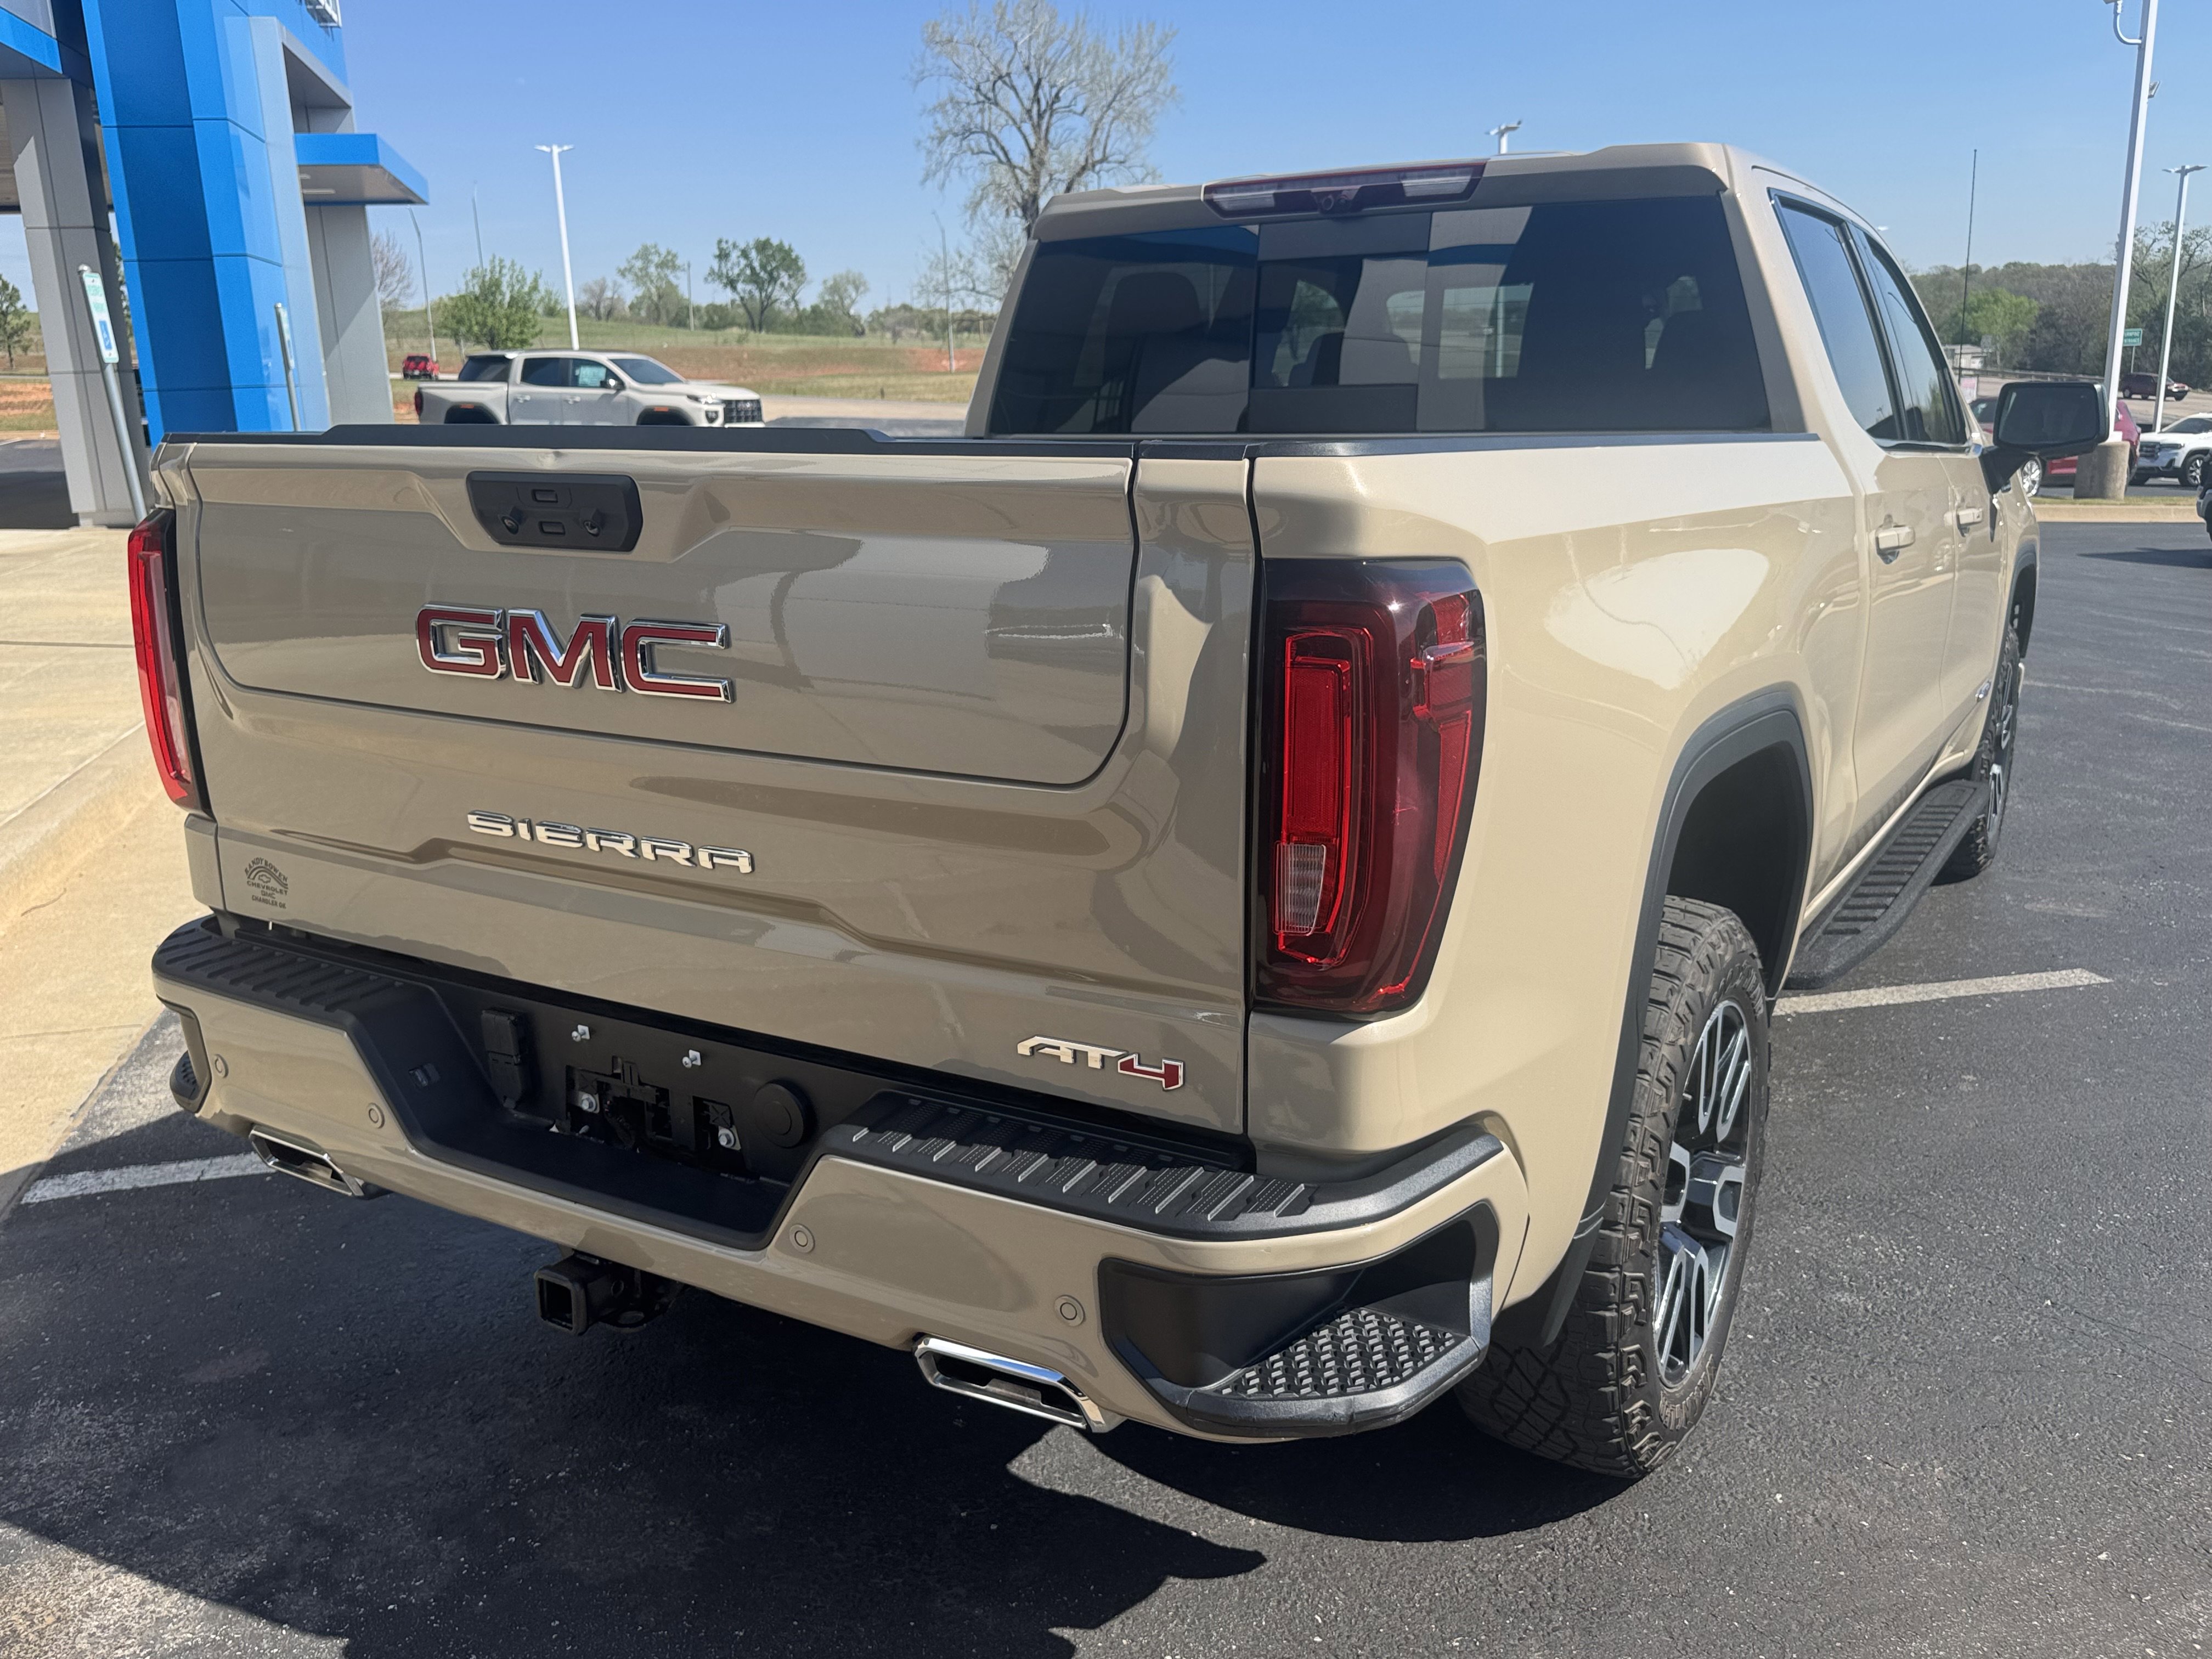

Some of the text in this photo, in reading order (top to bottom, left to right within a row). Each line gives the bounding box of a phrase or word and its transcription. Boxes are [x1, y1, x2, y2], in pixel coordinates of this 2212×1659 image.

[416, 601, 734, 703] GMC
[467, 809, 754, 874] SIERRA
[245, 857, 287, 883] RANDY BOWEN
[247, 880, 287, 896] CHEVROLET
[252, 895, 278, 907] CHANDLER
[261, 890, 275, 899] GMC
[1017, 1035, 1184, 1091] AT4
